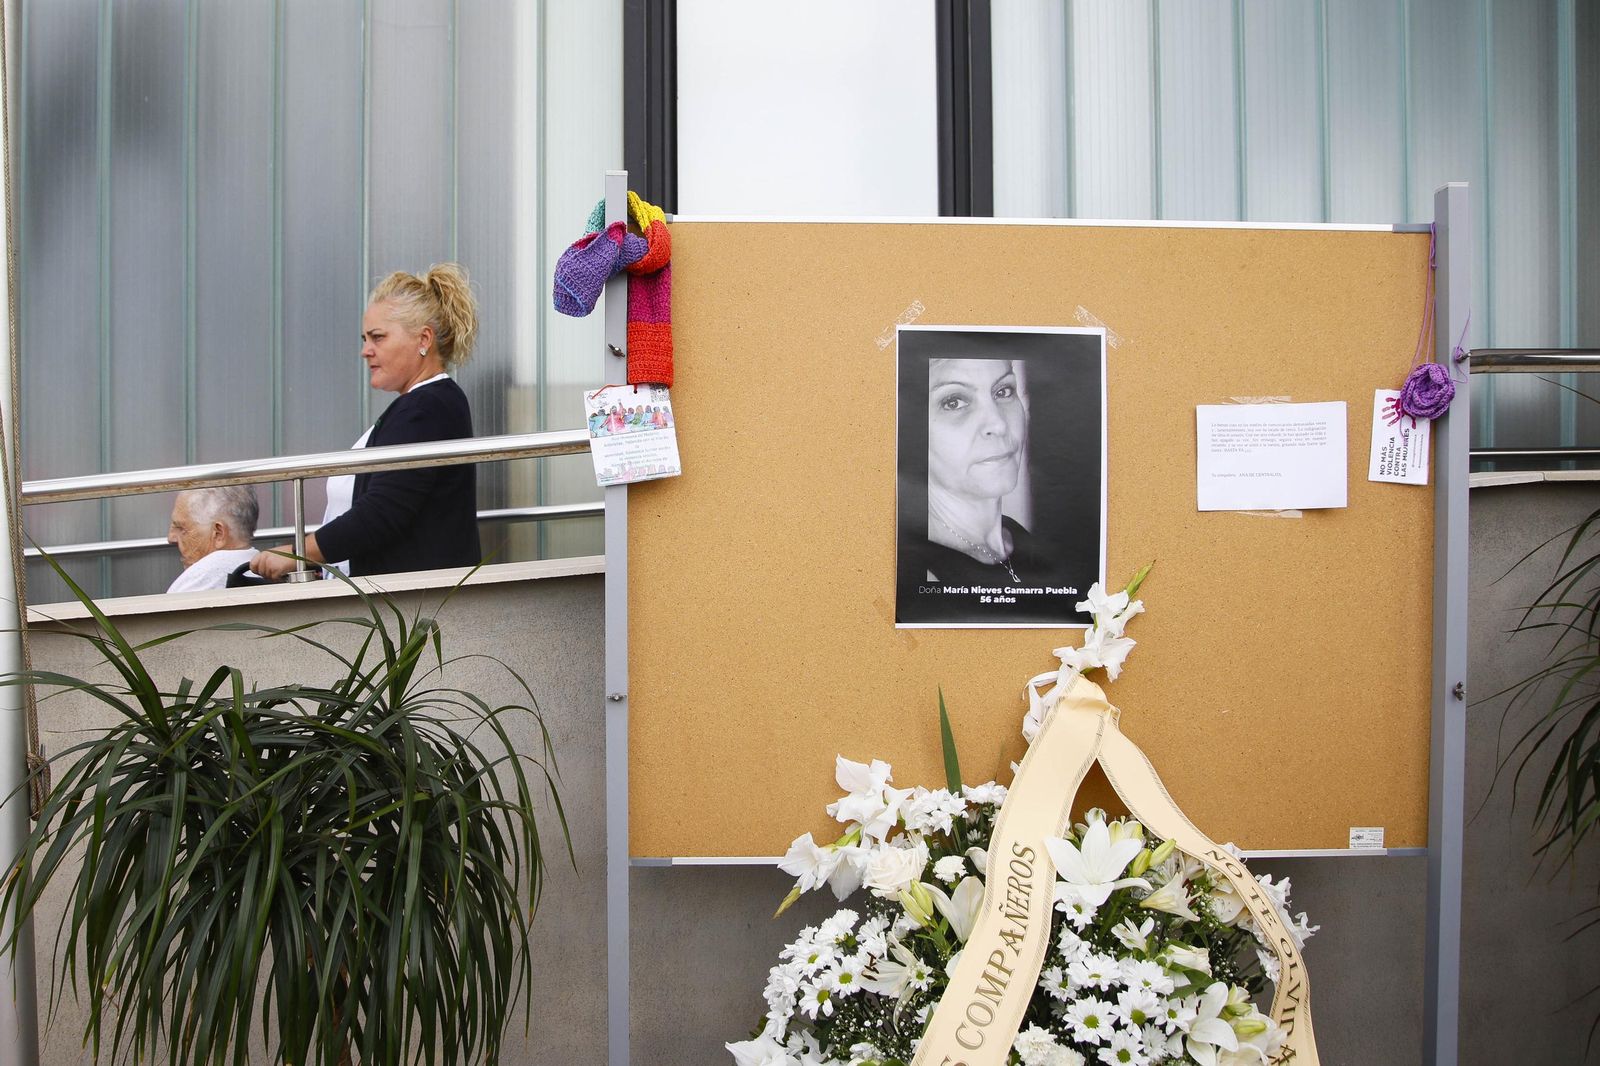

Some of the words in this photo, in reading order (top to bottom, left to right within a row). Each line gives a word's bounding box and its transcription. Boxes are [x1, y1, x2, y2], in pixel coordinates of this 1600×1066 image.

[1387, 437, 1395, 475] VIOLENCIA
[1402, 428, 1410, 461] MUJERES
[1380, 464, 1386, 475] NO
[918, 585, 941, 594] Doña
[943, 585, 969, 594] María
[971, 585, 1002, 594] Nieves
[1004, 586, 1043, 594] Gamarra
[1045, 586, 1078, 595] Puebla
[993, 595, 1016, 604] años
[1205, 849, 1243, 878] NO
[1249, 886, 1277, 927] TE
[955, 842, 1036, 1051] COMPAÑEROS
